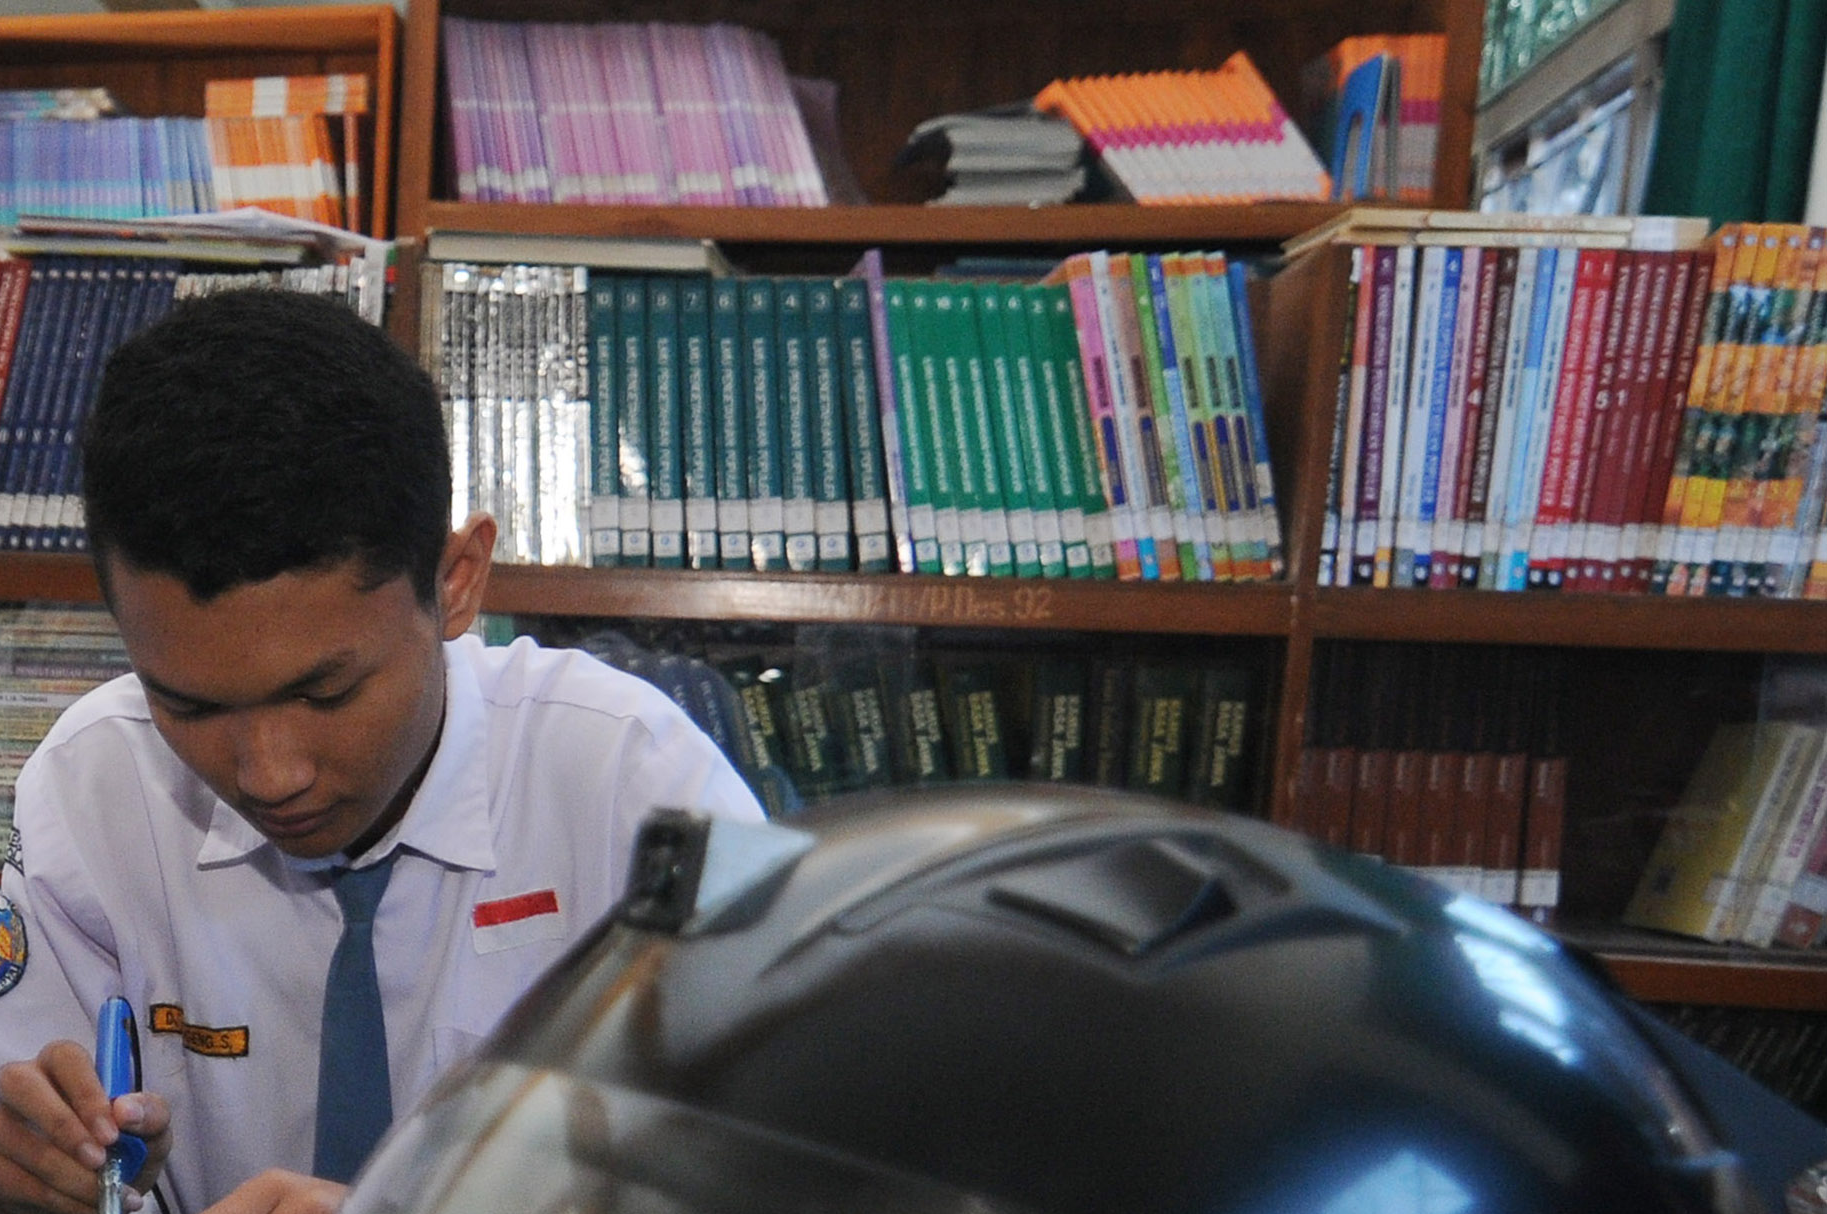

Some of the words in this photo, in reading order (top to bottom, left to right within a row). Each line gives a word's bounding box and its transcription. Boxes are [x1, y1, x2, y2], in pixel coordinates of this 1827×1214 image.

[595, 292, 612, 306] 10
[785, 295, 796, 308] 4
[848, 296, 860, 308] 2
